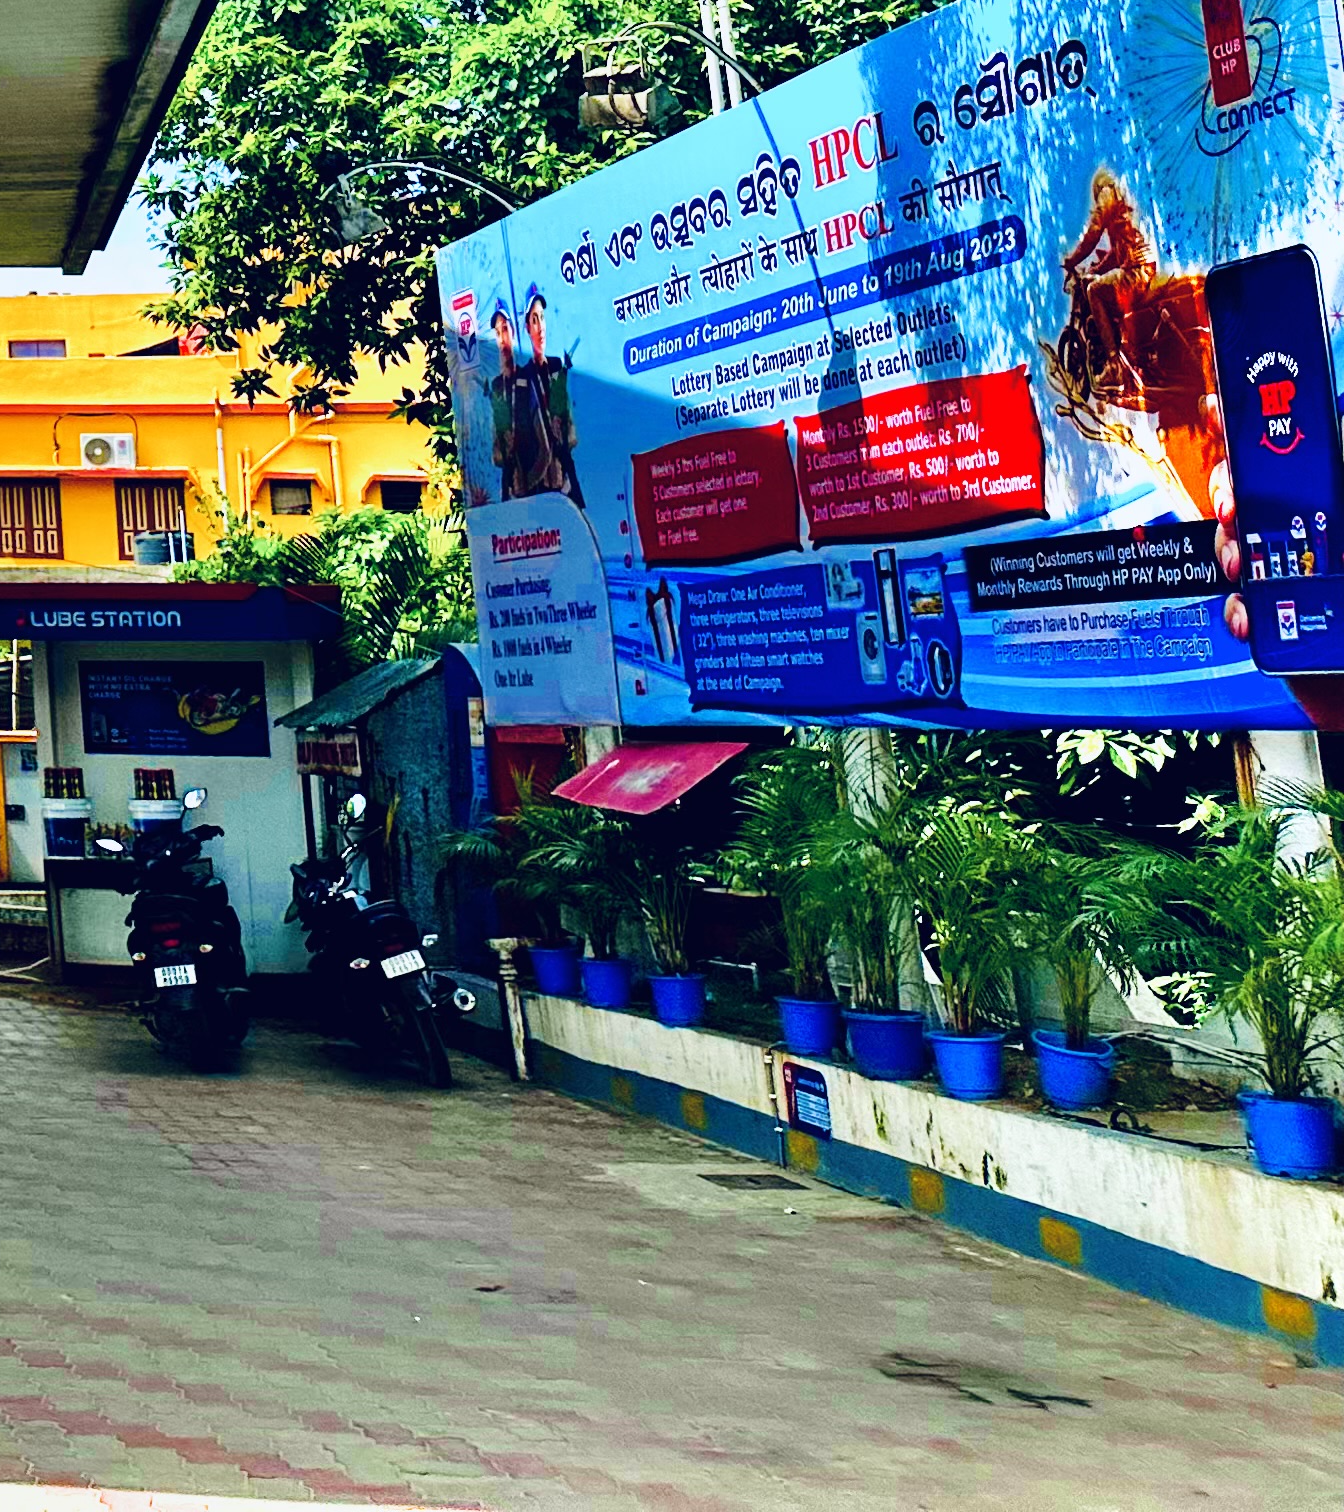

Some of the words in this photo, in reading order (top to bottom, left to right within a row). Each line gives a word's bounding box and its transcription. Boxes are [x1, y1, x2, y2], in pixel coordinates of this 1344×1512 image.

[1212, 39, 1241, 60] CLUB
[1221, 58, 1237, 76] HP
[1216, 87, 1296, 134] CONNECT
[809, 112, 899, 189] HPCL
[914, 100, 945, 147] ର
[614, 285, 660, 322] बरसात
[663, 264, 692, 306] और
[758, 234, 778, 273] के
[823, 201, 896, 254] HPCL
[899, 178, 930, 224] की
[629, 337, 682, 366] Duration
[685, 328, 701, 348] of
[702, 307, 778, 347] Campaign:
[780, 290, 815, 319] 20th
[818, 280, 859, 308] June
[862, 274, 880, 292] to
[884, 254, 922, 286] 19th
[925, 247, 965, 276] Aug
[970, 227, 1017, 261] 2023
[671, 364, 713, 397] Lottery
[715, 355, 751, 386] Based
[752, 343, 815, 376] Campaign
[816, 334, 831, 360] at
[834, 318, 893, 355] Selected
[897, 301, 958, 335] Outlets.
[1245, 350, 1276, 384] Happy
[1277, 350, 1300, 379] with
[675, 395, 729, 430] (Separate
[732, 385, 777, 416] Lottery
[778, 381, 803, 402] will
[804, 374, 820, 394] be
[822, 365, 856, 391] done
[859, 360, 875, 382] at
[876, 349, 911, 379] each
[915, 332, 967, 369] outlet)
[1258, 379, 1297, 418] HP
[1268, 417, 1292, 438] PAY
[990, 555, 1035, 576] (Winning
[1036, 549, 1095, 569] Customers
[1096, 545, 1116, 563] will
[1117, 546, 1137, 566] get
[1138, 540, 1181, 561] Weekly
[1183, 536, 1194, 555] &
[976, 580, 1016, 600] Monthly
[1017, 575, 1064, 595] Rewards
[1064, 571, 1112, 592] Through
[1112, 569, 1130, 587] HP
[1131, 566, 1155, 584] PAY
[1157, 565, 1182, 586] App
[1183, 561, 1218, 583] Only)
[30, 611, 87, 627] LUBE
[91, 610, 182, 627] STATION
